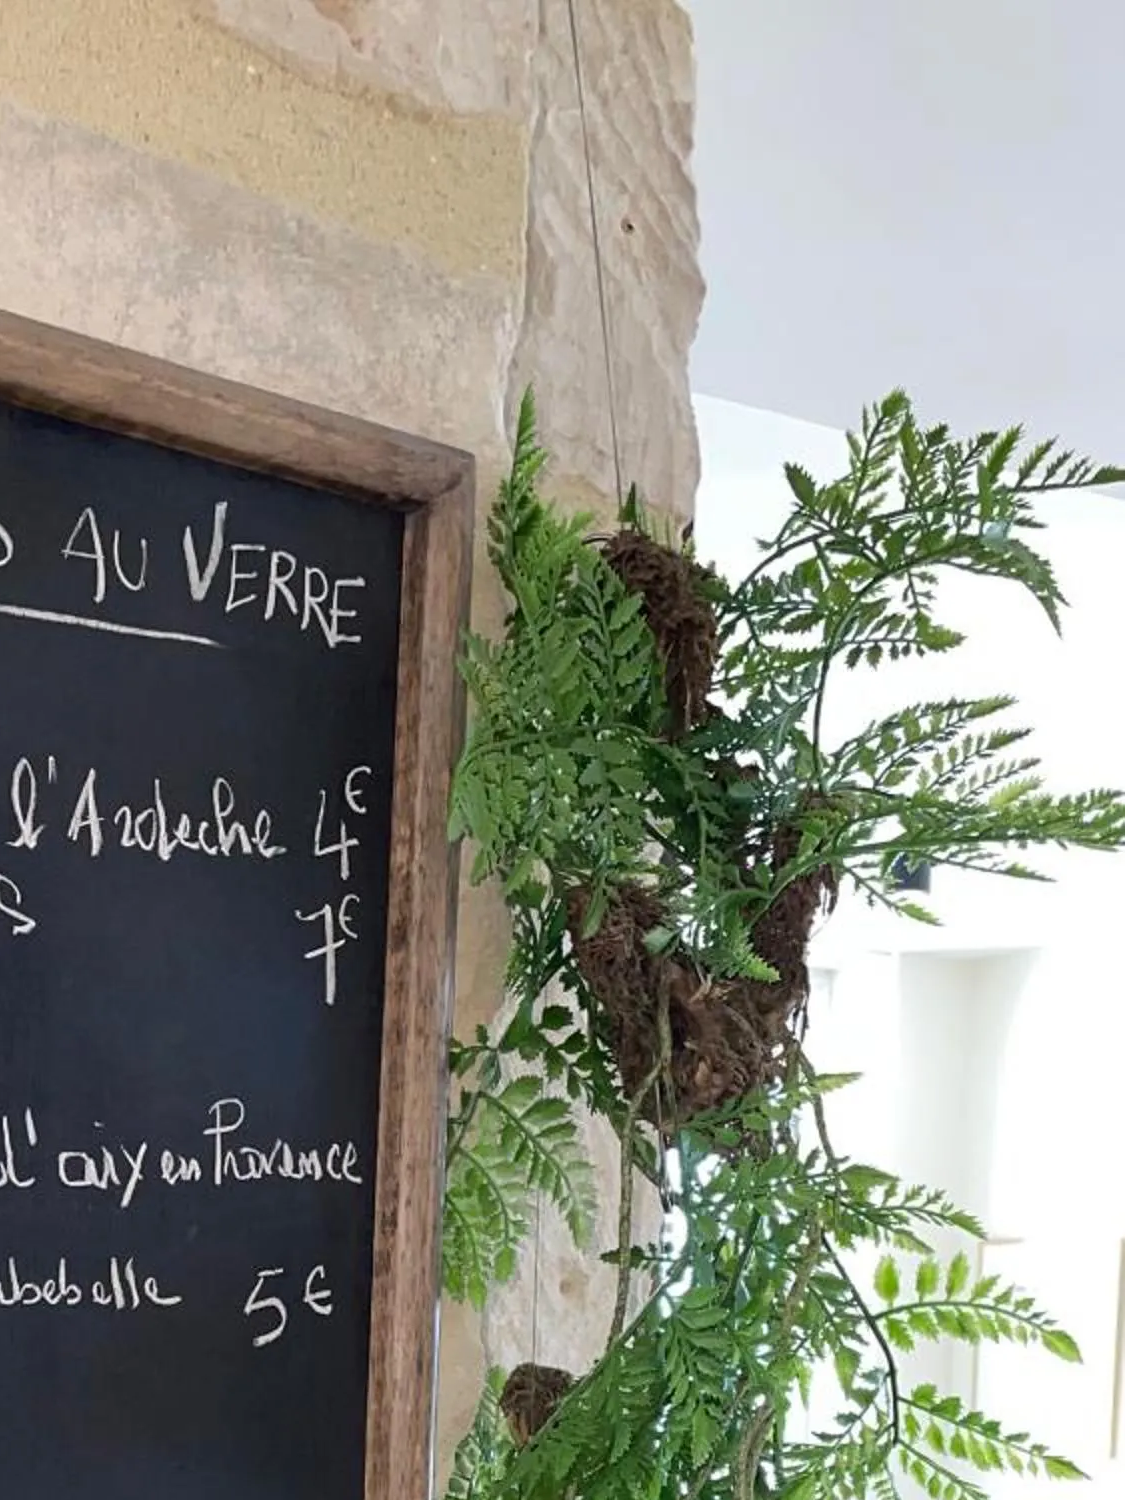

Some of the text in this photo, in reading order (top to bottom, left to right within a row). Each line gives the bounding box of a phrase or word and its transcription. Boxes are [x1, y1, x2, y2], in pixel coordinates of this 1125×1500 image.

[61, 507, 147, 603] AU
[182, 500, 365, 647] VERRE
[313, 766, 372, 880] 4€
[294, 893, 361, 1004] 7€
[161, 1152, 201, 1185] en
[203, 1097, 363, 1187] Provence
